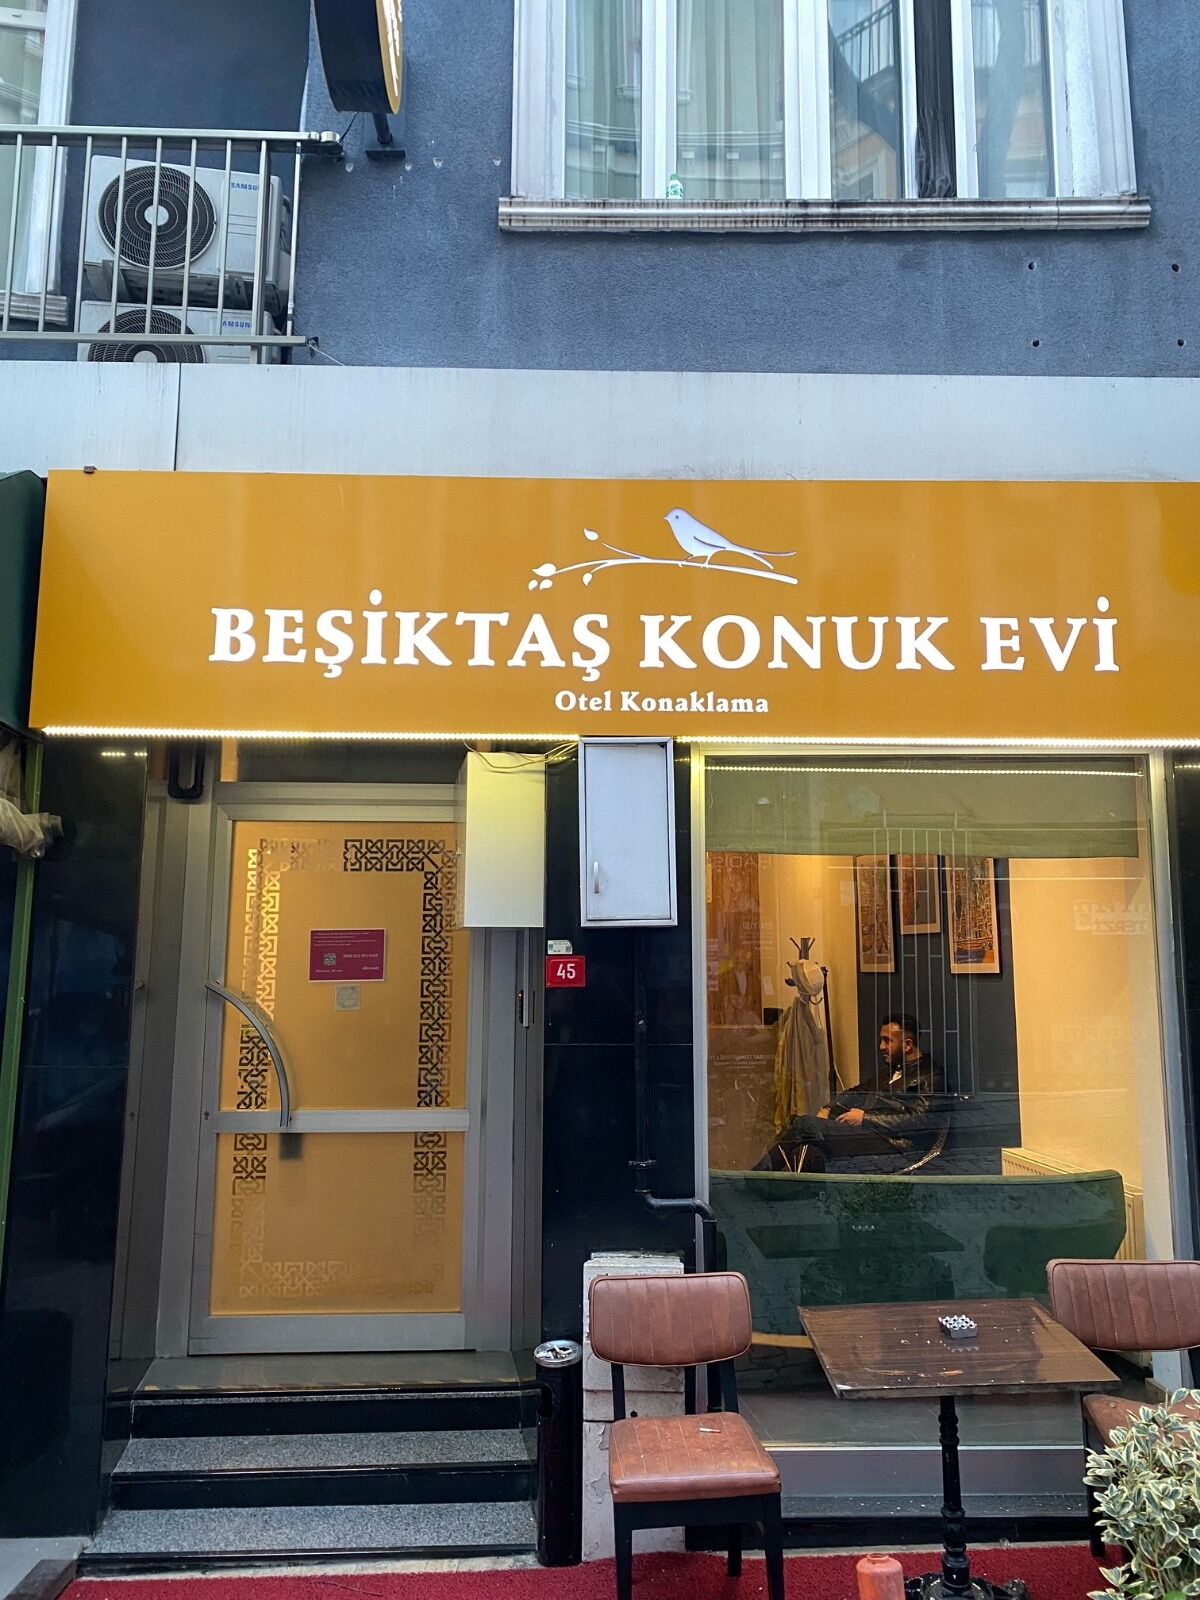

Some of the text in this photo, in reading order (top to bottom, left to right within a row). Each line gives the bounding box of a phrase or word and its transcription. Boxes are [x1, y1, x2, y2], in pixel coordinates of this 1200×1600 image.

[223, 320, 252, 328] AMSUN
[208, 590, 1120, 683] BEŞİKTAŞ KONUK EVİ
[555, 690, 769, 712] Otel Konaklama
[556, 963, 576, 980] 45
